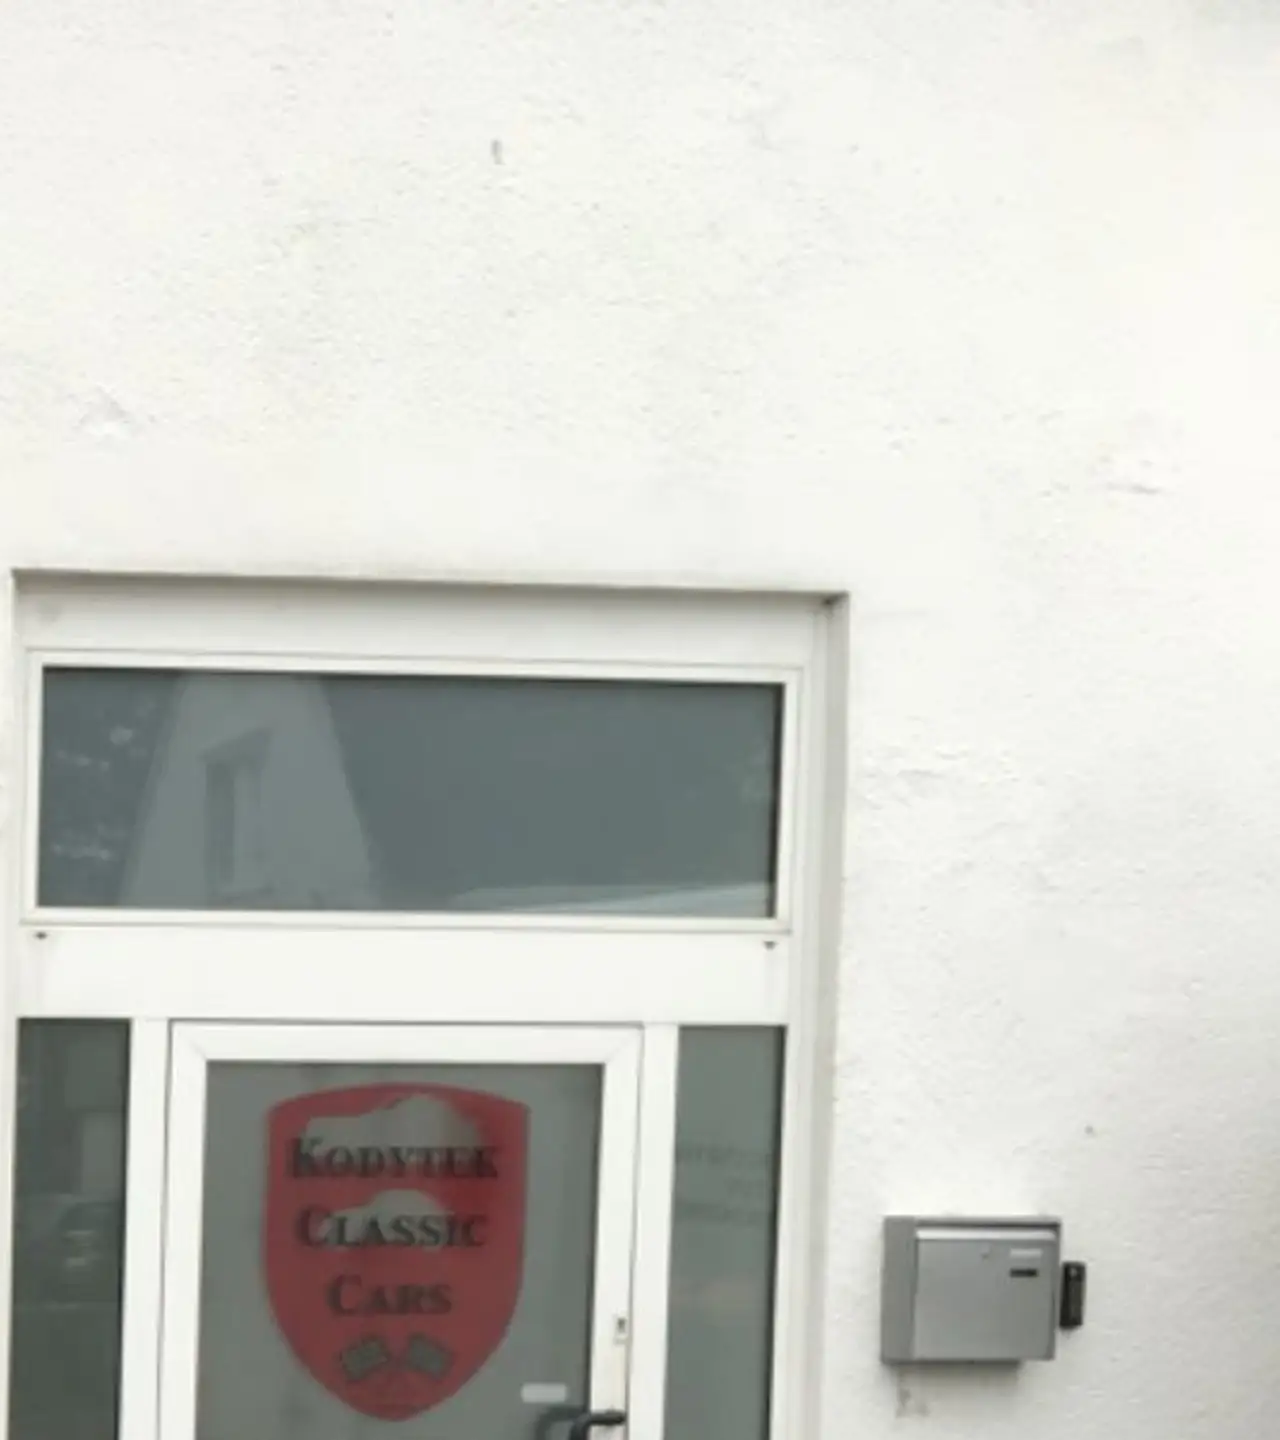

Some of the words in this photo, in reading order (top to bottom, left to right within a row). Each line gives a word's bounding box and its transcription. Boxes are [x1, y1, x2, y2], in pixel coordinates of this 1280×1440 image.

[286, 1137, 498, 1179] KODYTEK
[295, 1206, 487, 1249] CLASSIC
[326, 1275, 452, 1318] CARS
